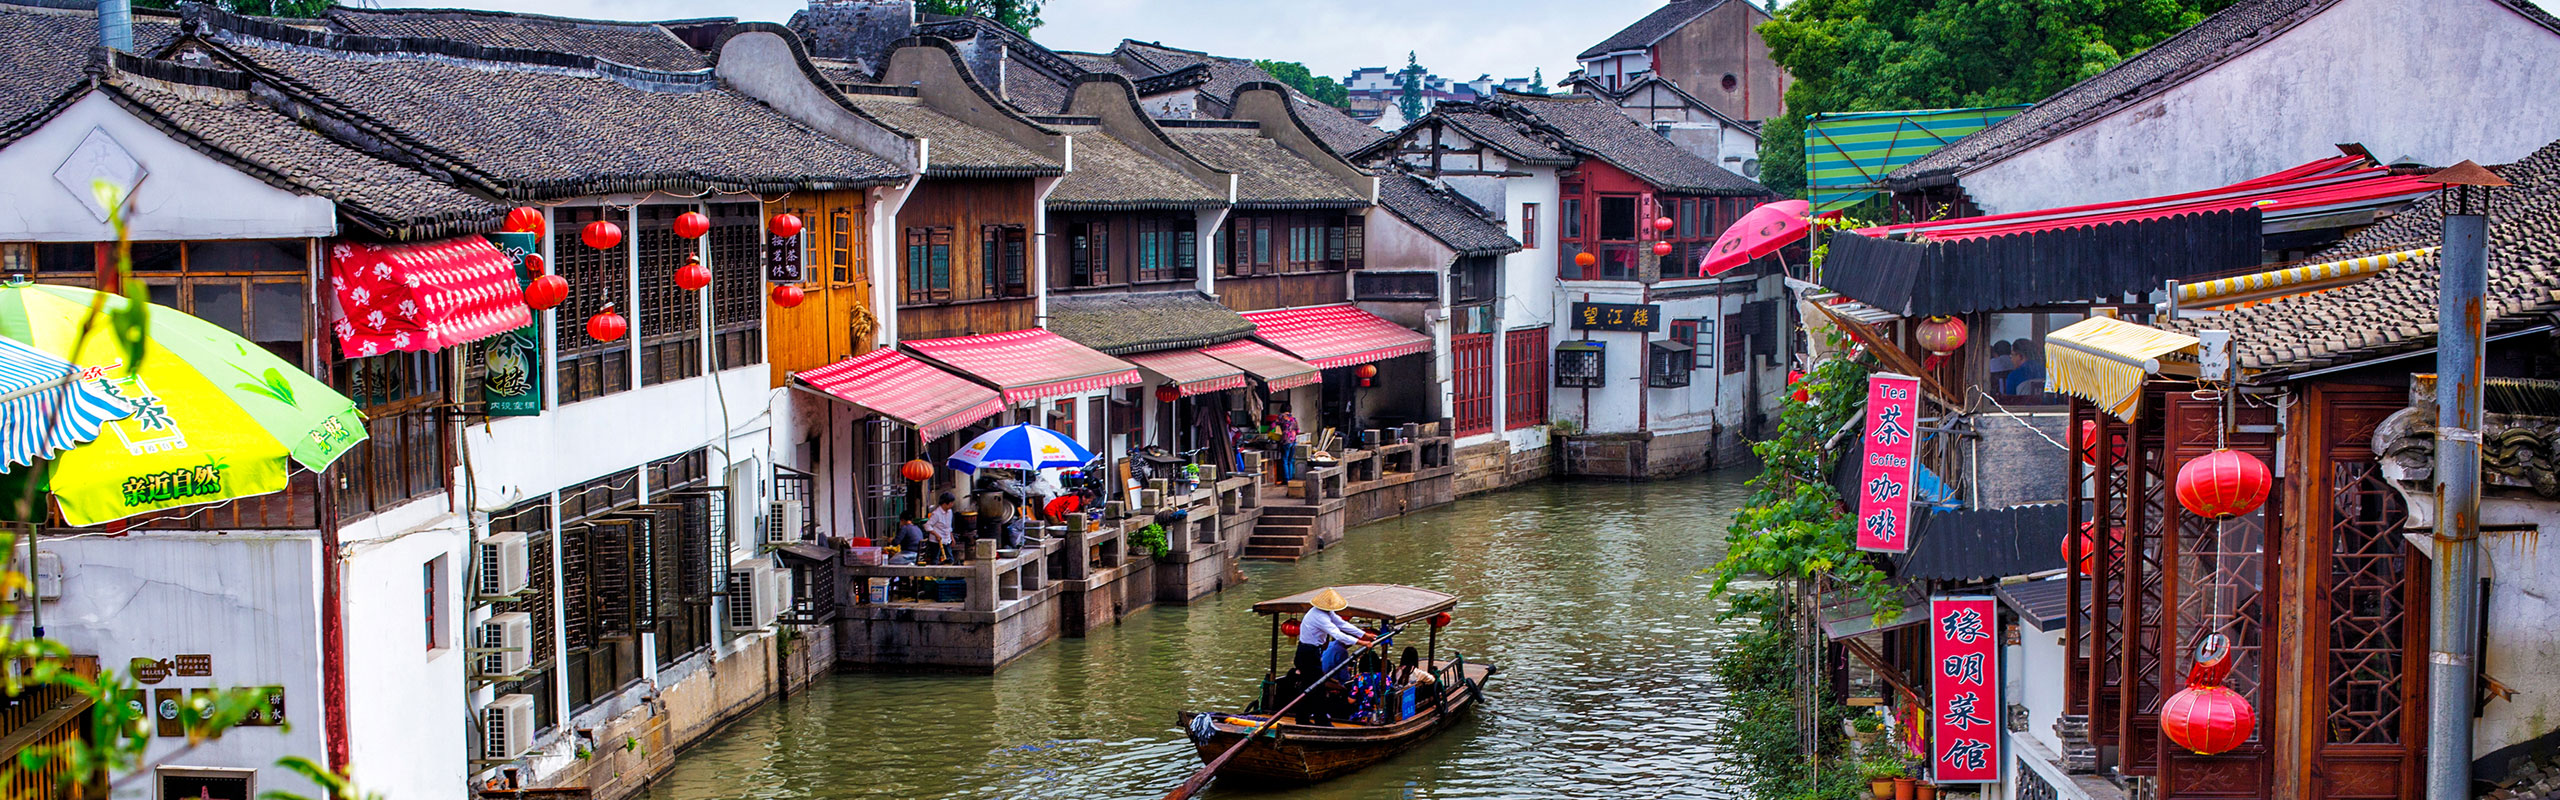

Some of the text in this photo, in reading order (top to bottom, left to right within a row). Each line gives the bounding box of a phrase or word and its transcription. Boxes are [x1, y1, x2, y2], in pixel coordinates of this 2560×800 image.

[1583, 306, 1649, 327] 望江楼
[488, 331, 535, 398] 茶楼
[1880, 384, 1907, 399] Tea
[1871, 404, 1910, 445] 茶
[1870, 453, 1907, 467] Coffee
[123, 464, 222, 507] 亲近自然
[1866, 473, 1902, 542] 咖啡
[1941, 608, 1991, 771] 缘明菜馆
